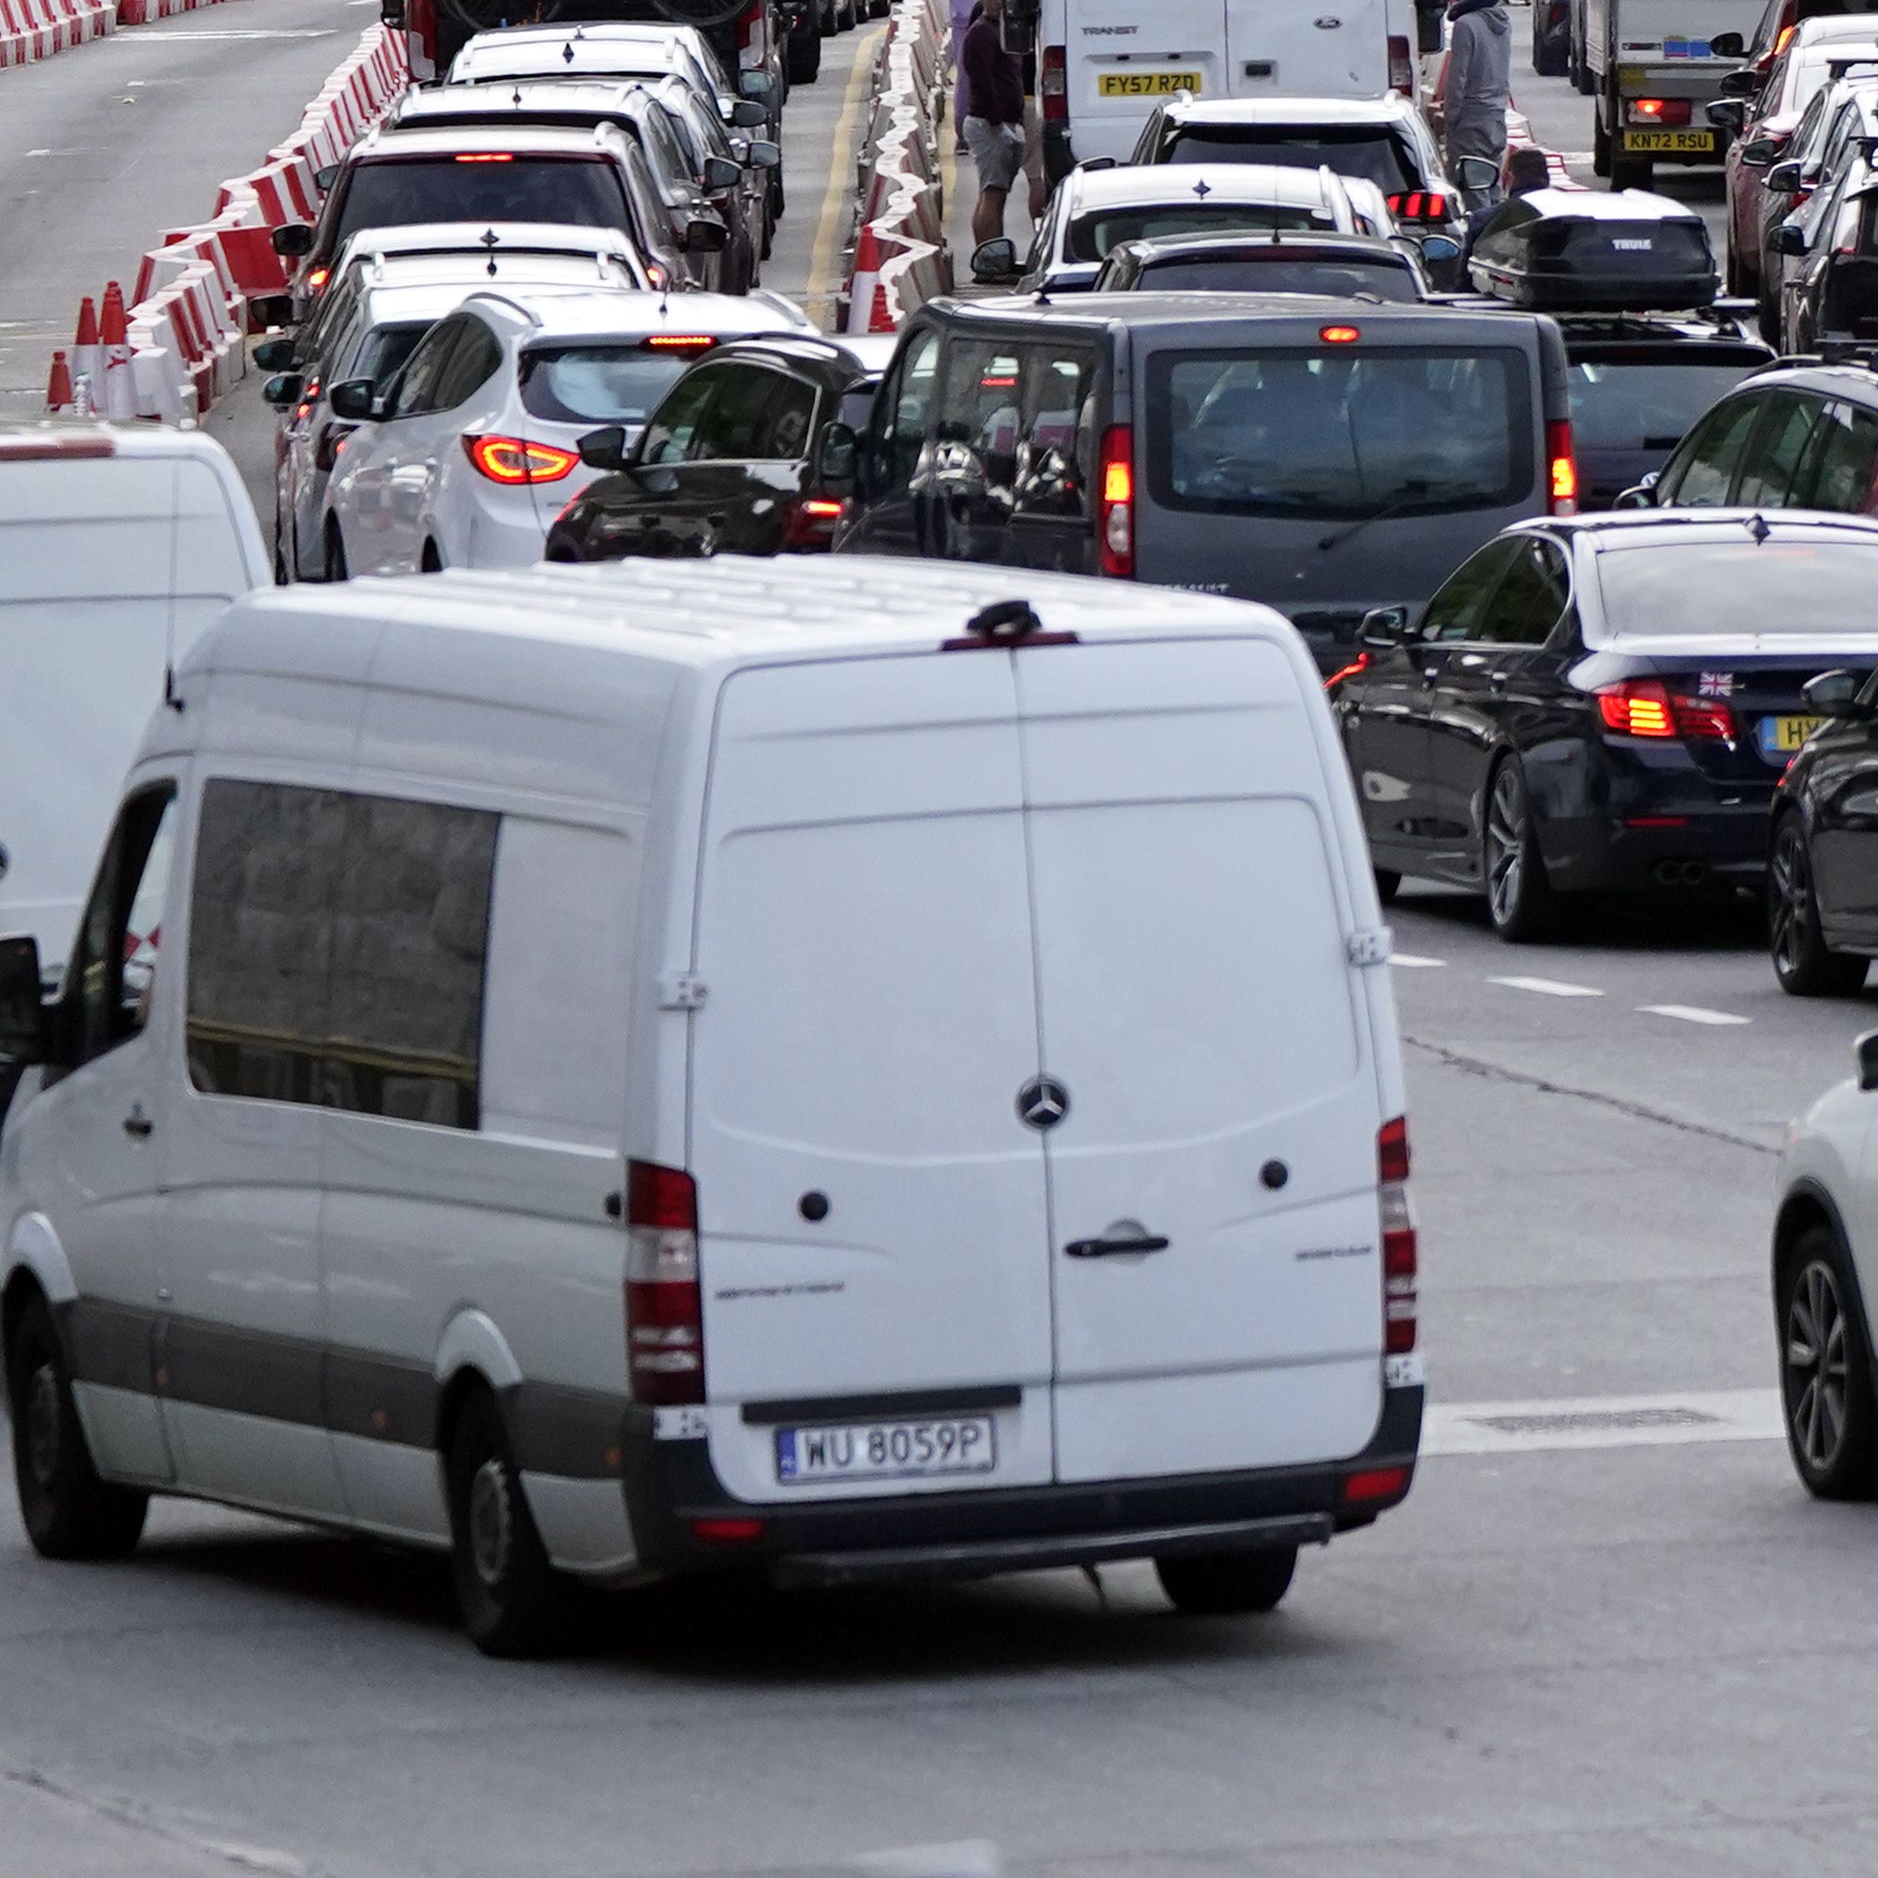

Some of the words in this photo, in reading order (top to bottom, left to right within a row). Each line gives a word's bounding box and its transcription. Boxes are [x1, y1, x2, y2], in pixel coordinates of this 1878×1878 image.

[1081, 25, 1140, 36] TRANSIT
[1105, 77, 1153, 93] FY57
[1630, 133, 1672, 149] KN72
[1677, 133, 1708, 149] RSU
[805, 1425, 853, 1468] WU
[868, 1422, 981, 1463] 8059P
